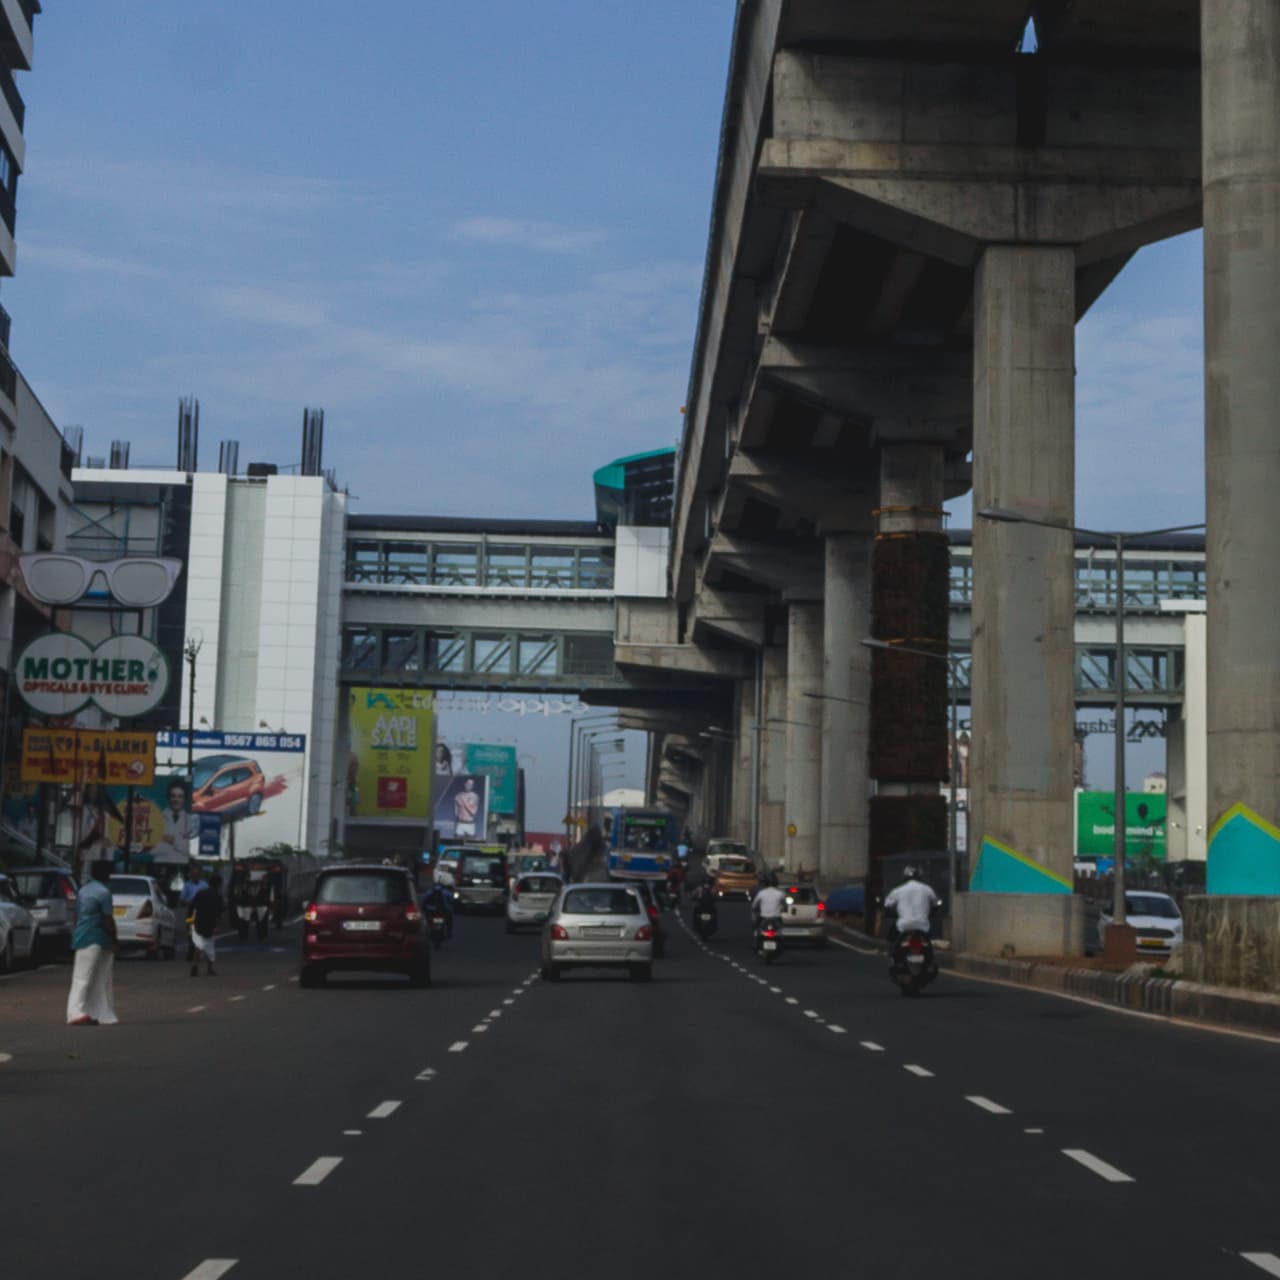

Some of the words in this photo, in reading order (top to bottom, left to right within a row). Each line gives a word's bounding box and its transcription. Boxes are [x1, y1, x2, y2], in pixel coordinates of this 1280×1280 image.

[24, 657, 145, 682] MOTHER
[23, 681, 78, 694] OPTICALS
[89, 683, 113, 694] EYE
[113, 683, 148, 695] CLINIC
[370, 729, 417, 748] SALE
